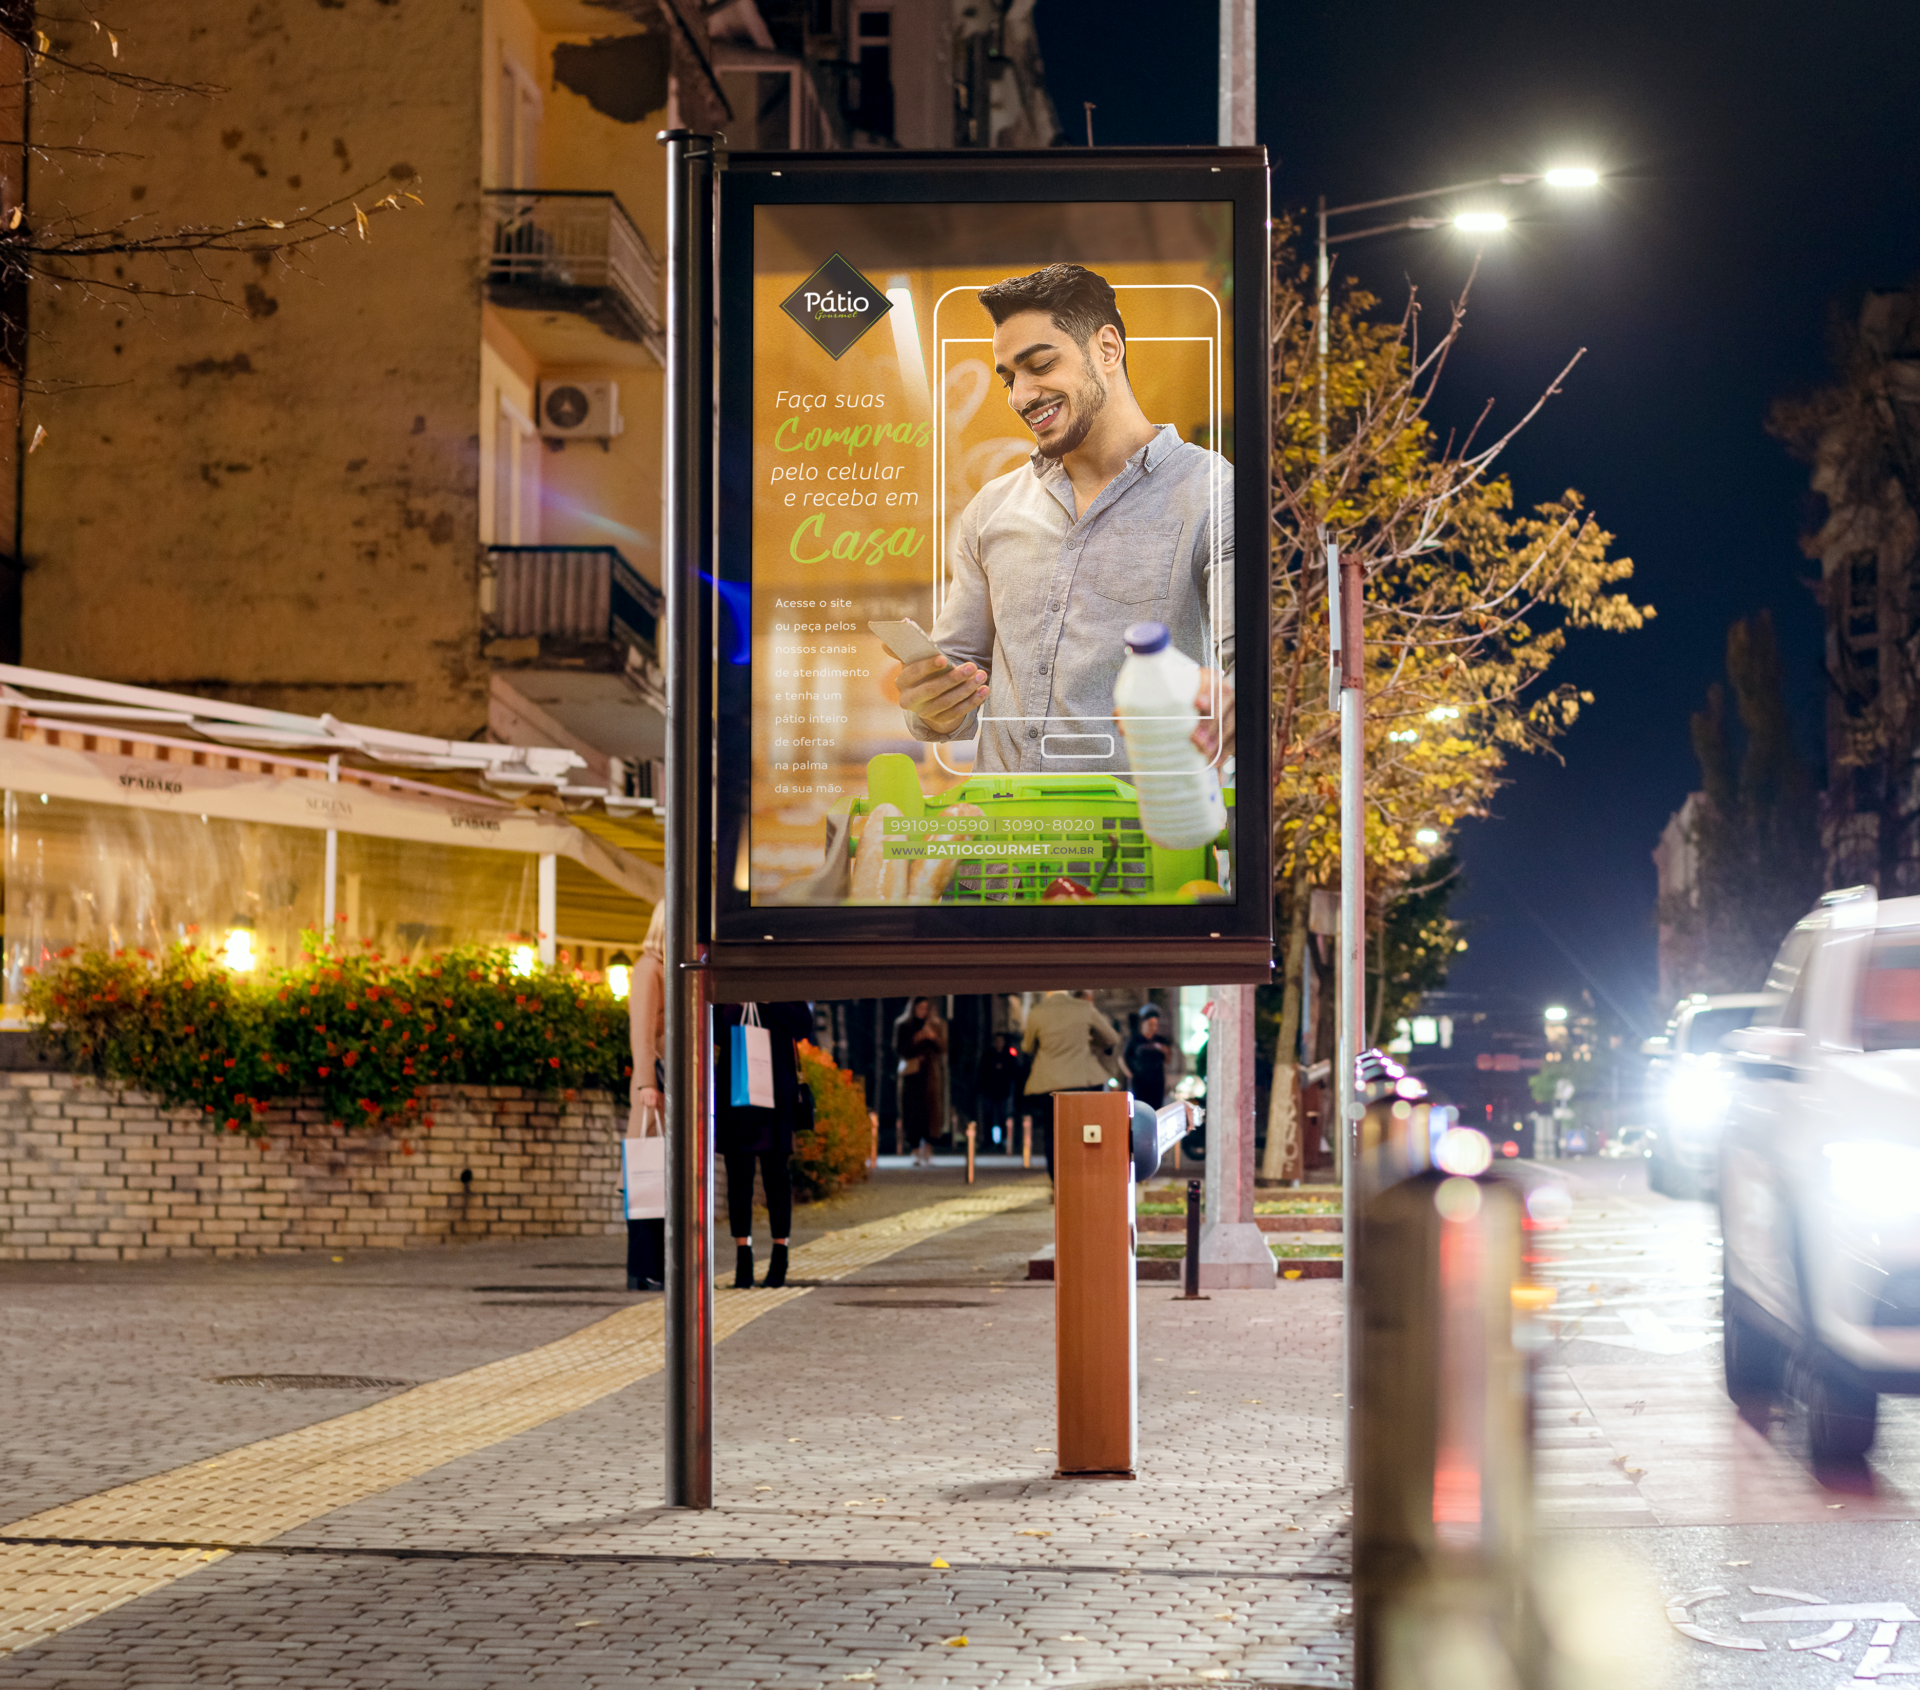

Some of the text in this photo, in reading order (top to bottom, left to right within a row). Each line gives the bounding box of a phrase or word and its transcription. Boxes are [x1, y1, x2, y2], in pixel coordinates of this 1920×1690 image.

[804, 290, 869, 312] Pátio
[814, 309, 858, 321] Gourmet
[776, 391, 885, 412] Faça suas
[774, 416, 935, 457] Compras
[771, 462, 905, 485] pelo celular
[784, 489, 918, 507] e receba em
[790, 512, 925, 566] Casa
[775, 598, 852, 608] Acesse o site
[775, 621, 857, 633] ou peça pelos
[775, 644, 857, 654] nossos canais
[775, 667, 870, 678] de atendimento
[775, 690, 842, 701] e tenha um
[775, 713, 848, 725] pátio inteiro
[774, 736, 835, 746] de ofertas
[774, 760, 828, 772] na palma
[774, 783, 845, 794] da sua mão.
[890, 819, 989, 832] 99109-0590
[1002, 819, 1094, 832] 3090-8020
